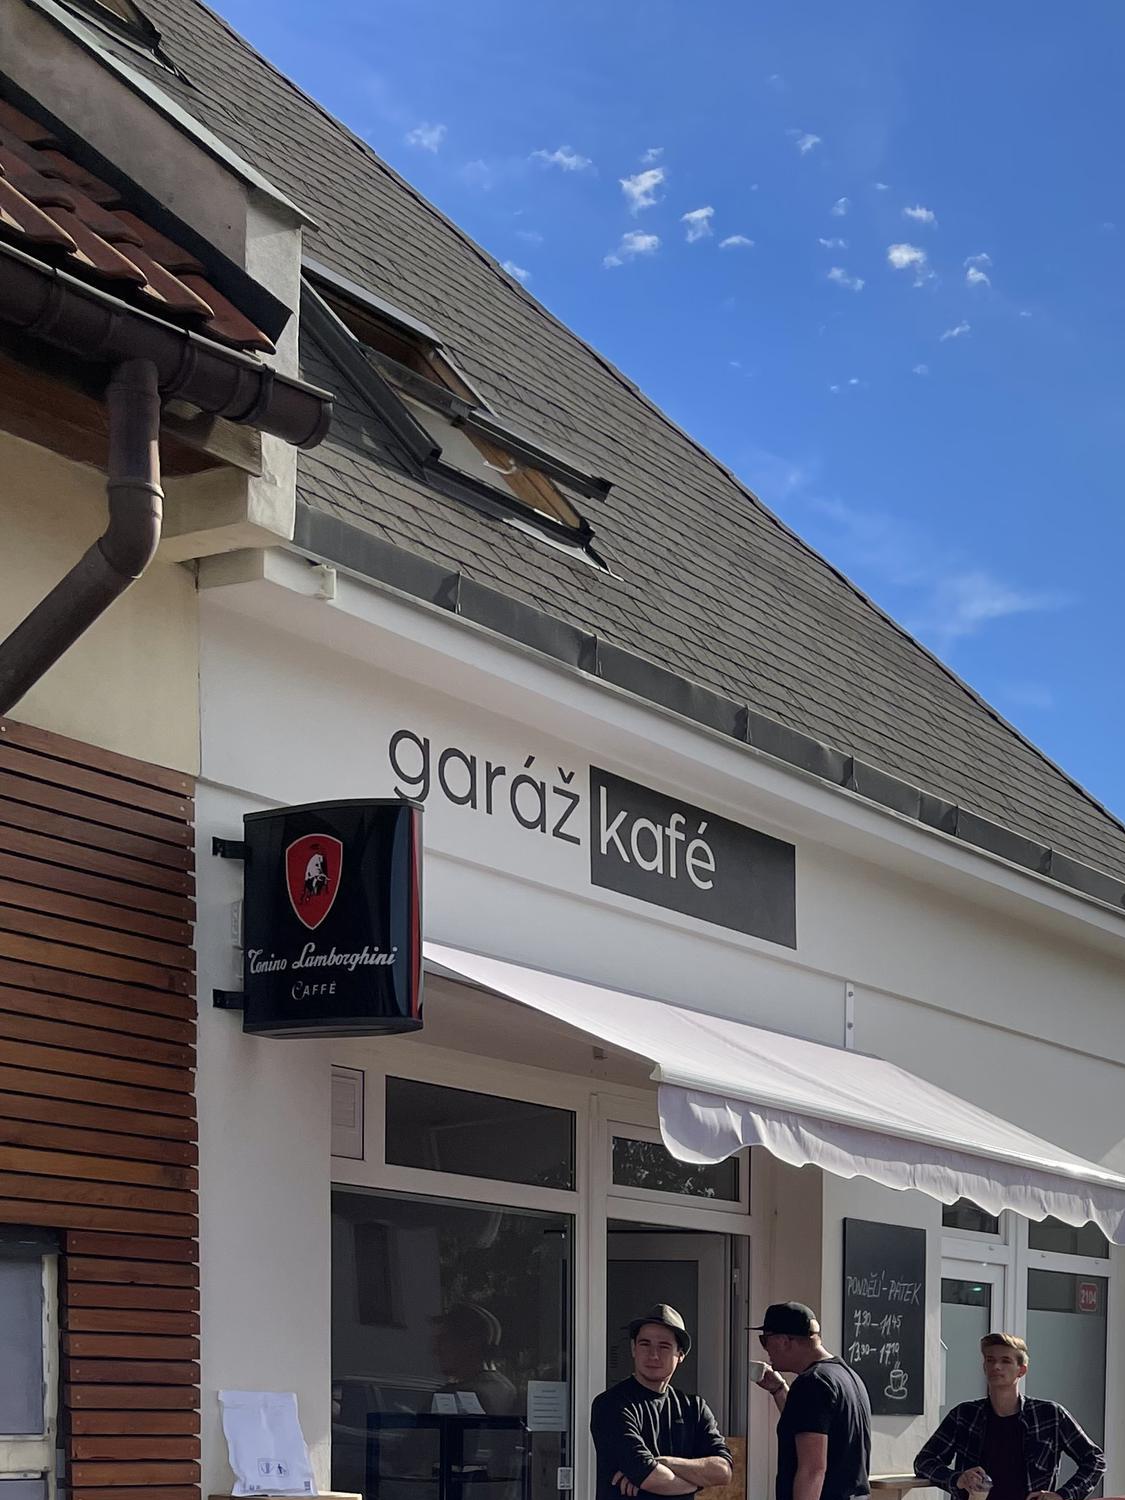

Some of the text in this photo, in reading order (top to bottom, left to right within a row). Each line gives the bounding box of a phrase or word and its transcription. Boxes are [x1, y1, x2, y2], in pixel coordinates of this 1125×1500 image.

[389, 729, 716, 890] garáž kafé
[248, 942, 398, 974] Tonino Lamborghini
